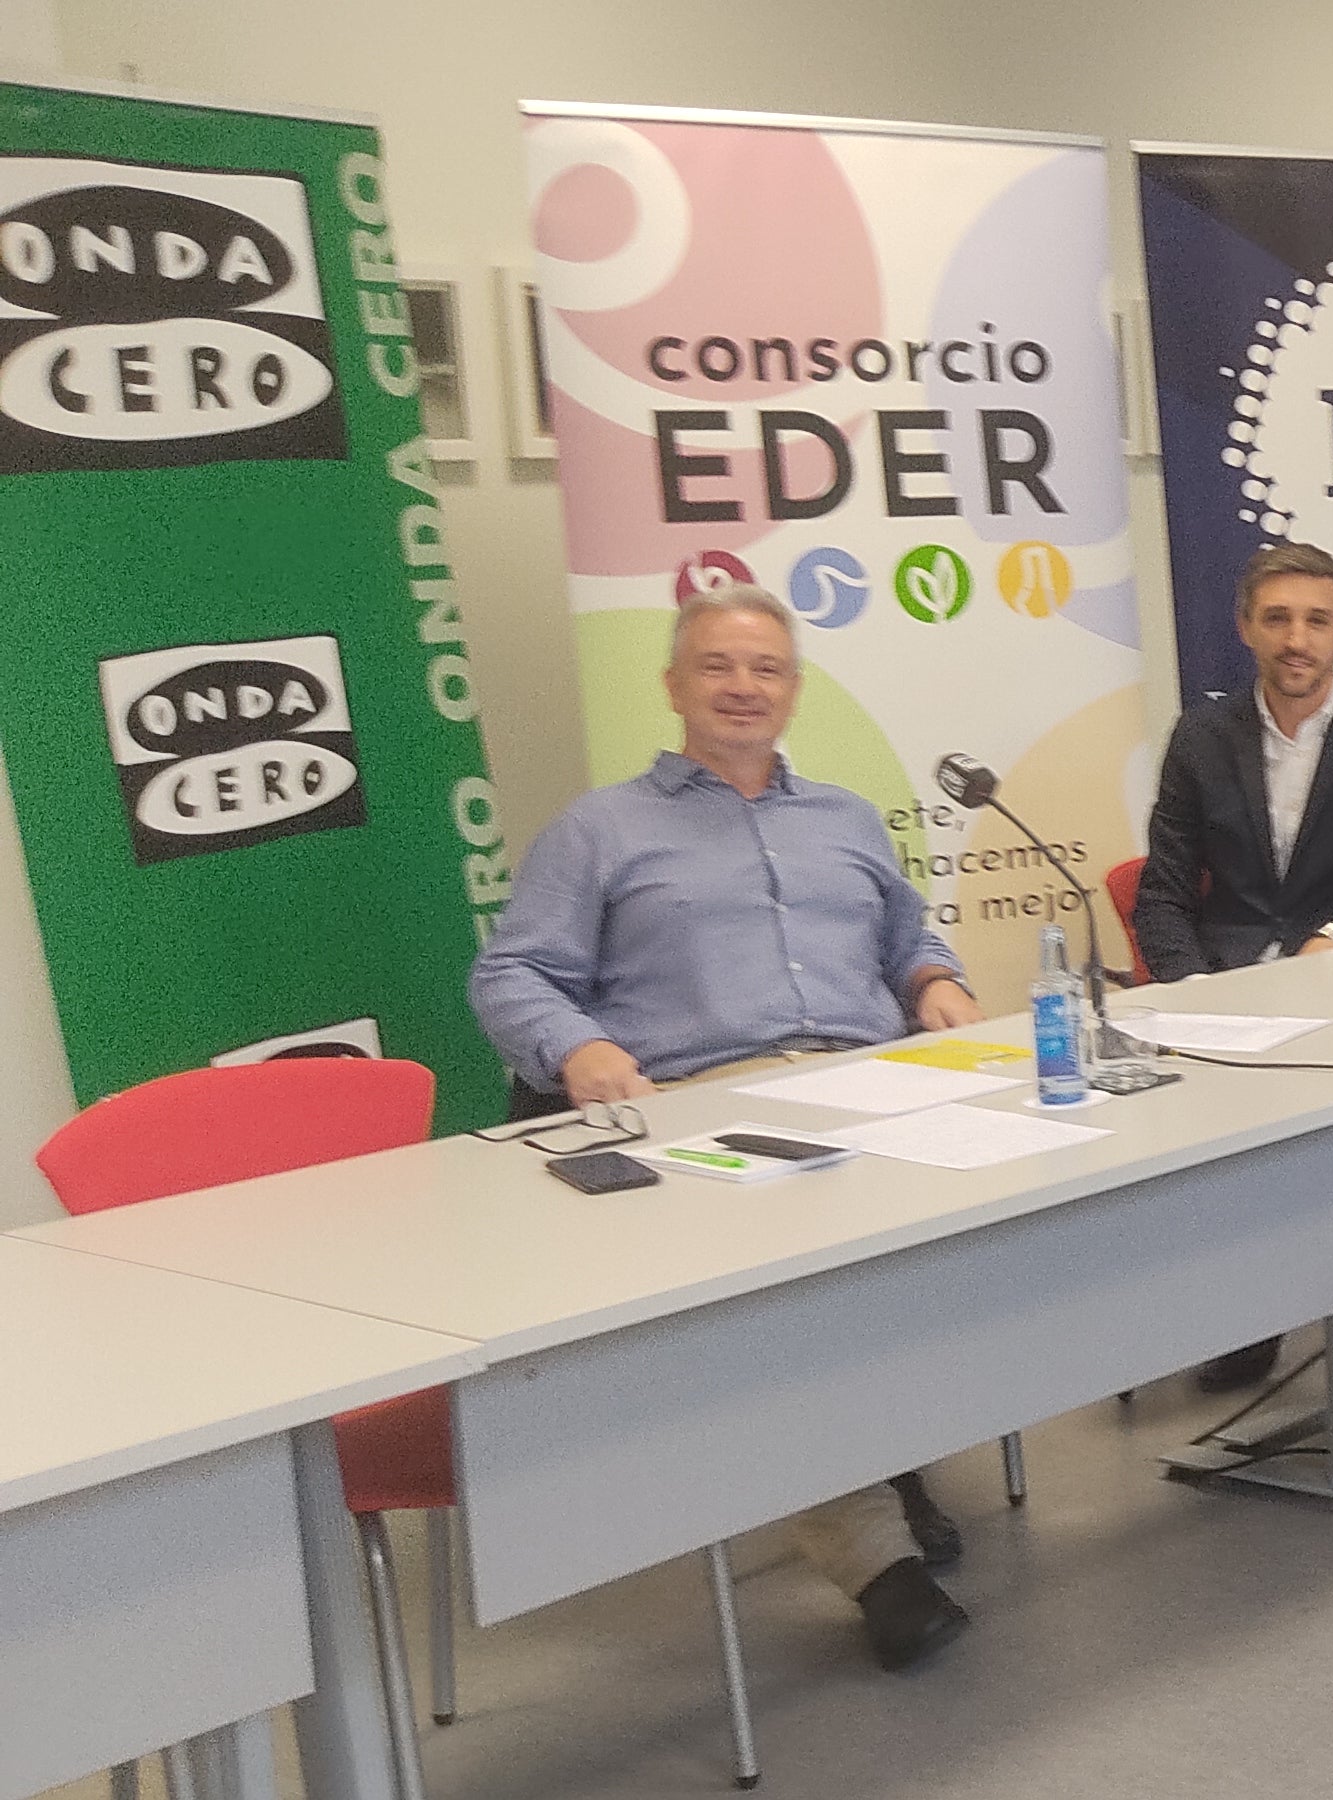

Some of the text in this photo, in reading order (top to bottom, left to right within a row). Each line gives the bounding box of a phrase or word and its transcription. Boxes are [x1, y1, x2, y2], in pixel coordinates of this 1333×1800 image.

[1, 222, 273, 284] ONDA
[338, 151, 421, 398] CERO
[49, 344, 287, 414] CERO
[648, 321, 1053, 384] consorcio
[652, 408, 1068, 523] EDER
[386, 434, 479, 723] ONDA
[137, 679, 320, 737] ONDA
[173, 758, 326, 819] CERO
[897, 840, 1089, 880] hacemos
